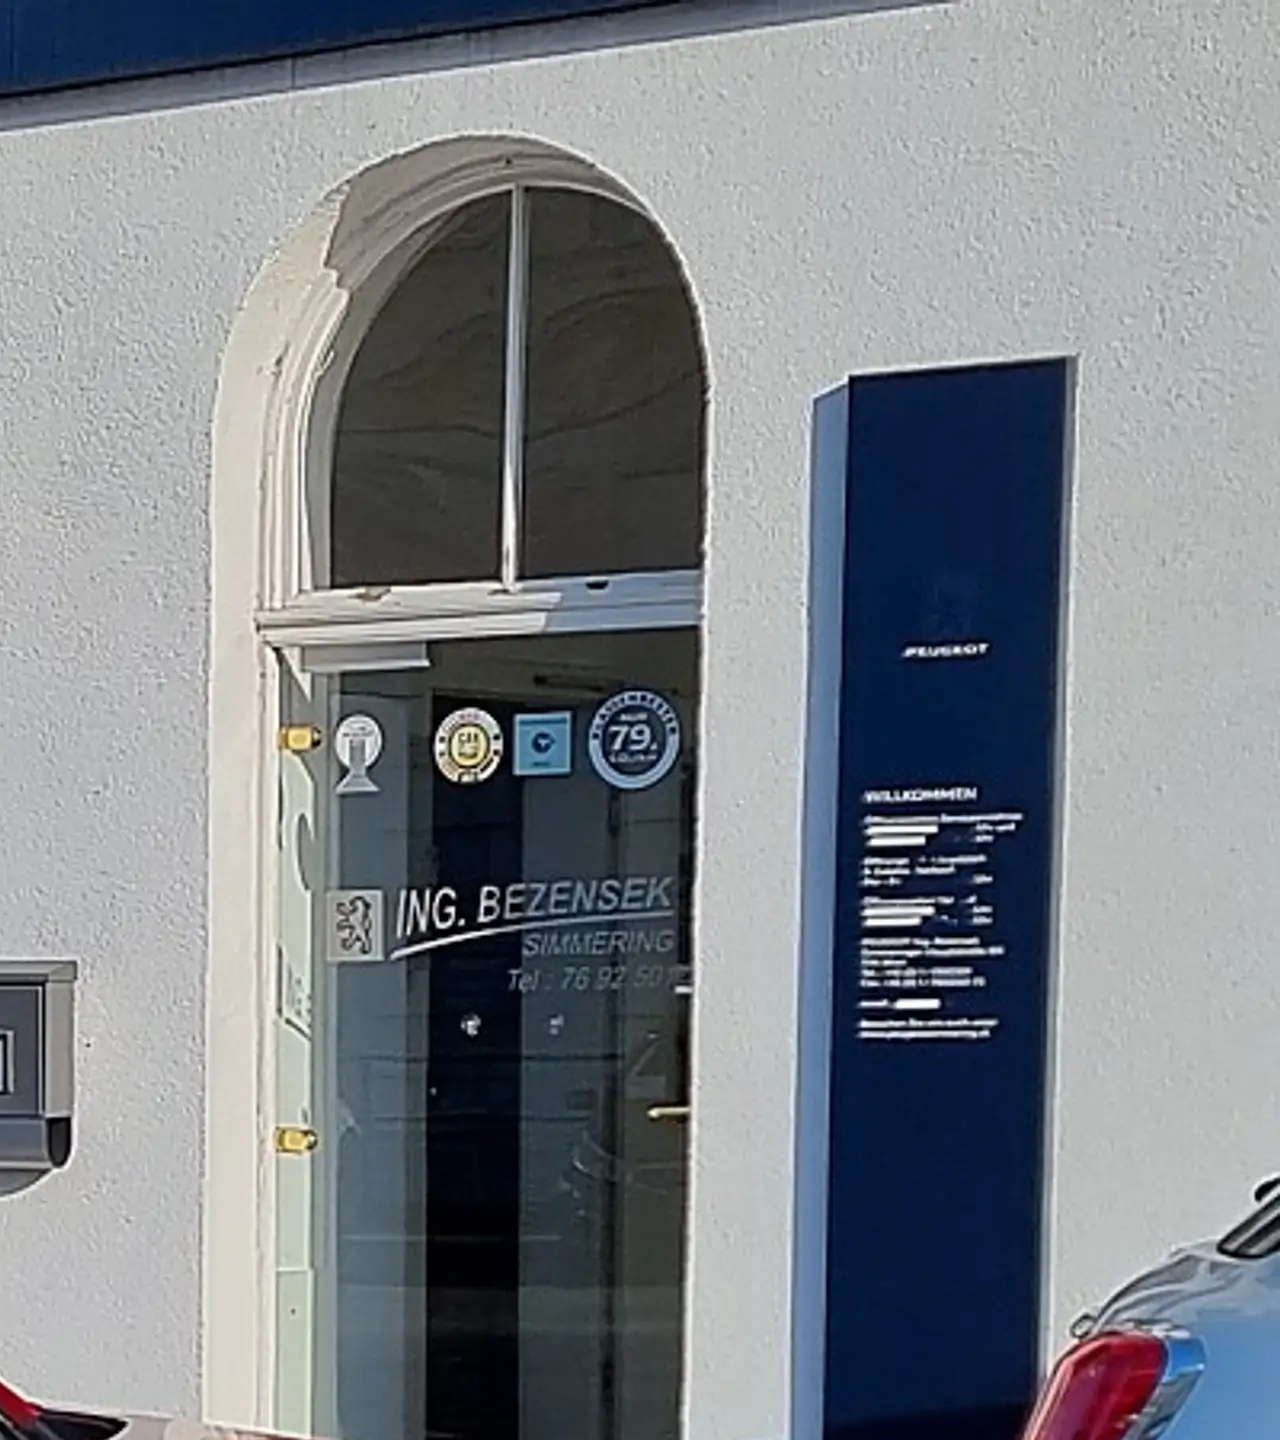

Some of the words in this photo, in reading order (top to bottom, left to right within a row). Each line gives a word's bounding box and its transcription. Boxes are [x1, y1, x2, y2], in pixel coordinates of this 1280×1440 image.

[902, 643, 990, 659] PEUGEOT
[863, 786, 978, 804] WILLKOMMEN
[395, 887, 467, 939] ING.
[477, 877, 672, 923] BEZENSEK
[523, 929, 676, 957] SIMMERING
